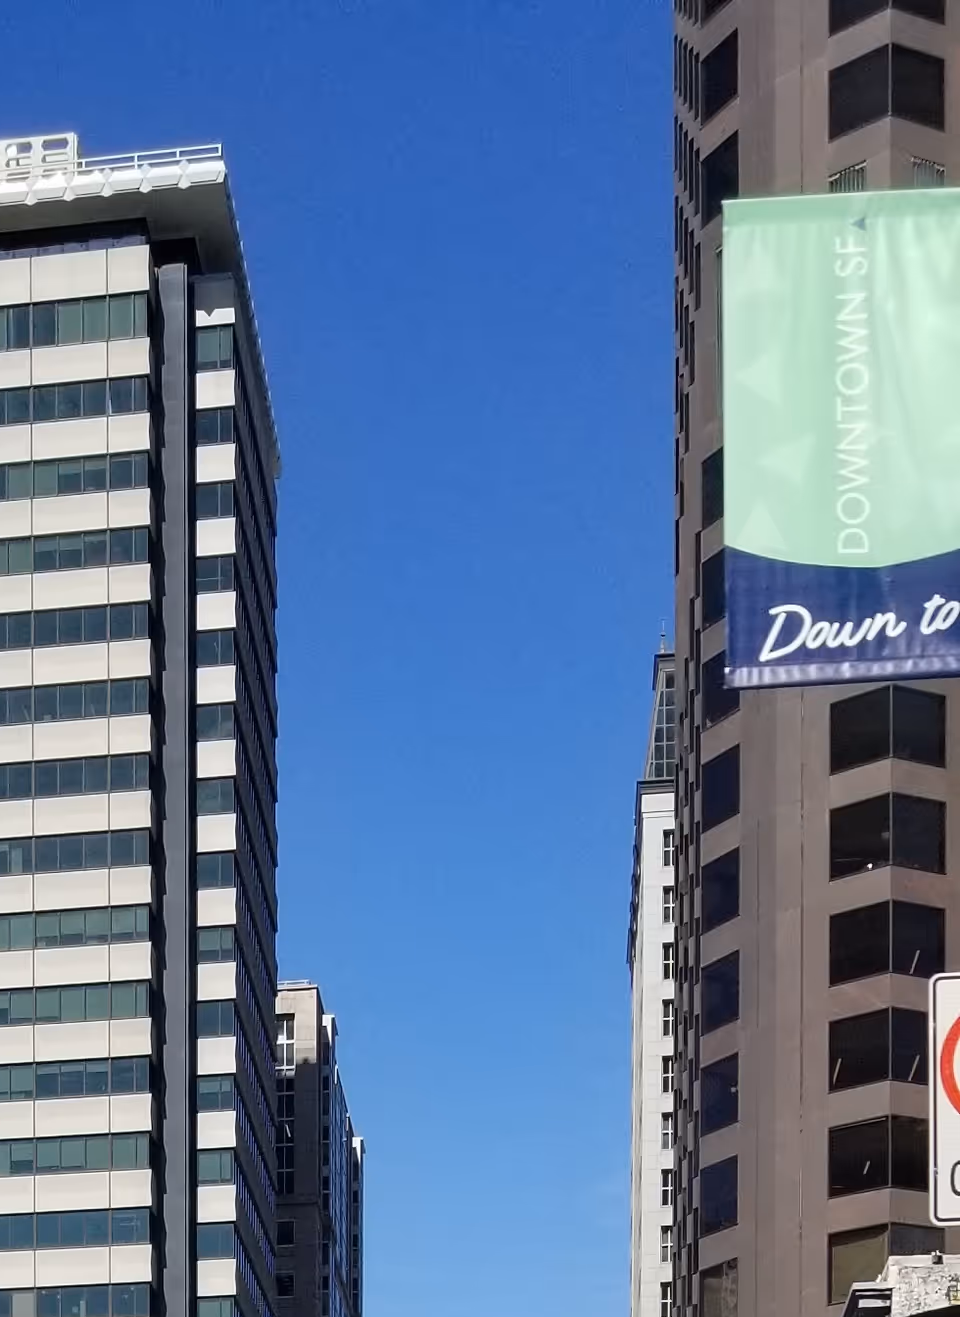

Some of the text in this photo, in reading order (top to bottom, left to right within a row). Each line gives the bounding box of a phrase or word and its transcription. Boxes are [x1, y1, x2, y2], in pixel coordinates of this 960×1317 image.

[834, 236, 870, 555] DOWNTOWN SF
[759, 593, 960, 663] Down to
